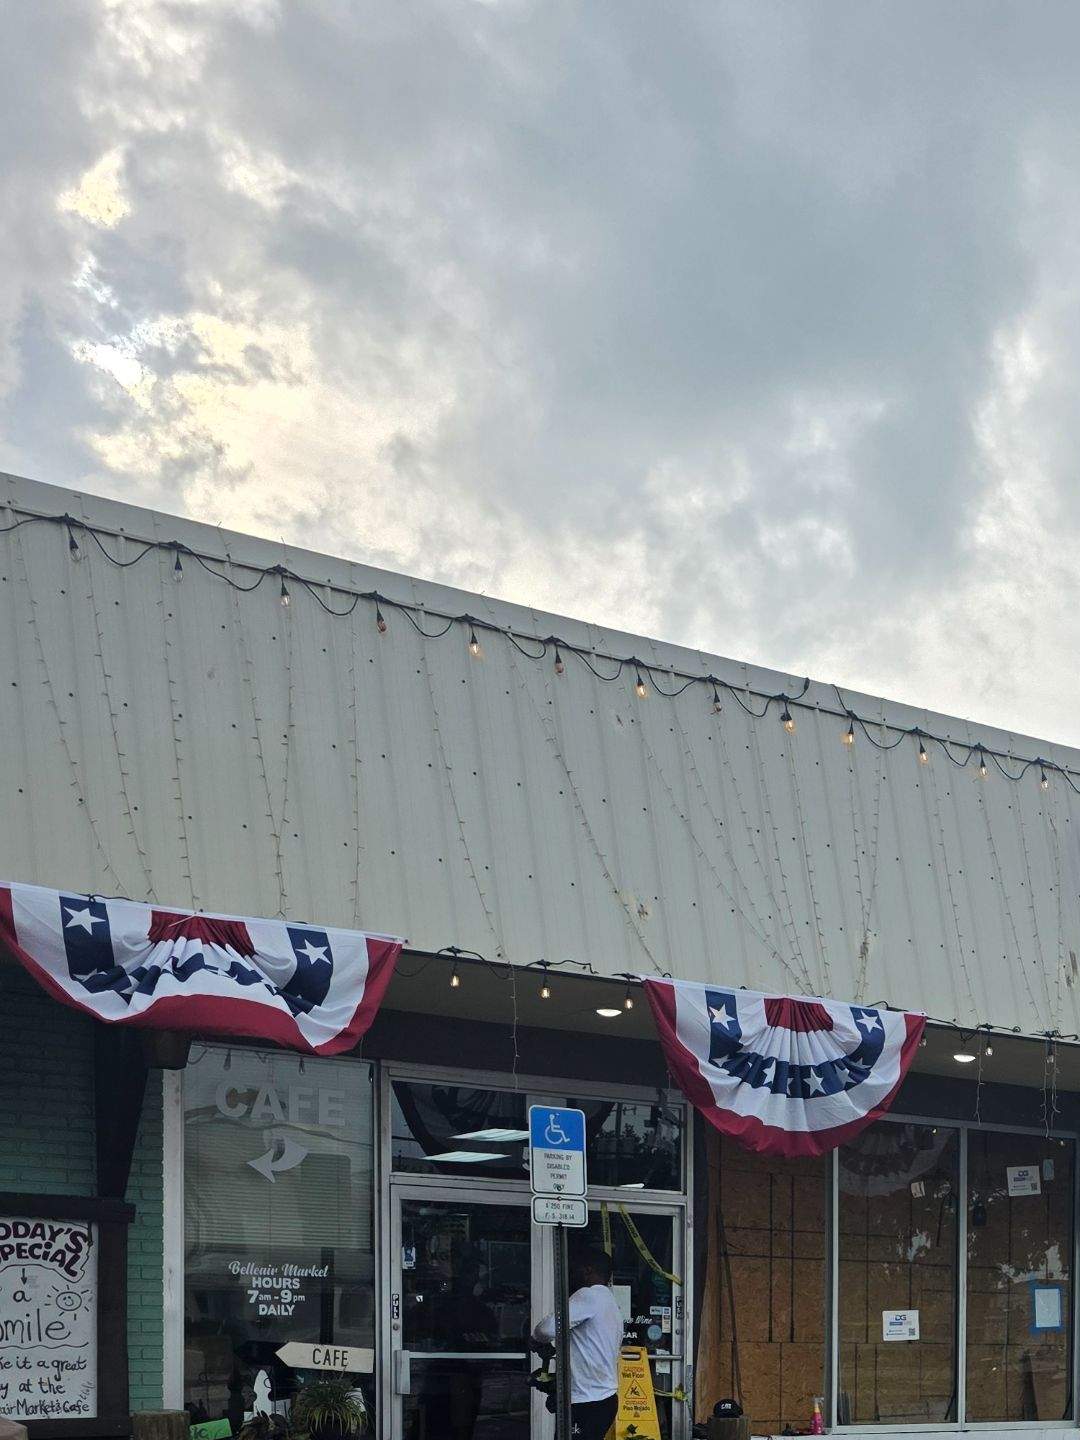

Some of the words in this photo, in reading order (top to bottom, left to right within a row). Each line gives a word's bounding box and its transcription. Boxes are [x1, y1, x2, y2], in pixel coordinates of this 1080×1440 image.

[215, 1081, 346, 1127] CAFE
[544, 1152, 565, 1161] PARKING
[546, 1163, 571, 1171] DISABLED
[0, 1221, 89, 1254] ODAY'S
[0, 1241, 81, 1278] PECiAL
[228, 1261, 278, 1278] Belleair
[281, 1263, 330, 1278] Market
[252, 1277, 301, 1289] HOURS
[247, 1289, 272, 1304] 7am
[280, 1289, 306, 1304] 9pm
[258, 1304, 296, 1317] DAILY
[392, 1294, 400, 1320] PULL
[0, 1308, 72, 1344] mile
[312, 1348, 349, 1367] CAFE
[16, 1355, 32, 1370] it
[37, 1360, 50, 1369] a
[51, 1355, 88, 1382] great
[19, 1378, 34, 1394] at
[38, 1377, 66, 1395] the
[62, 1399, 90, 1415] Cafe
